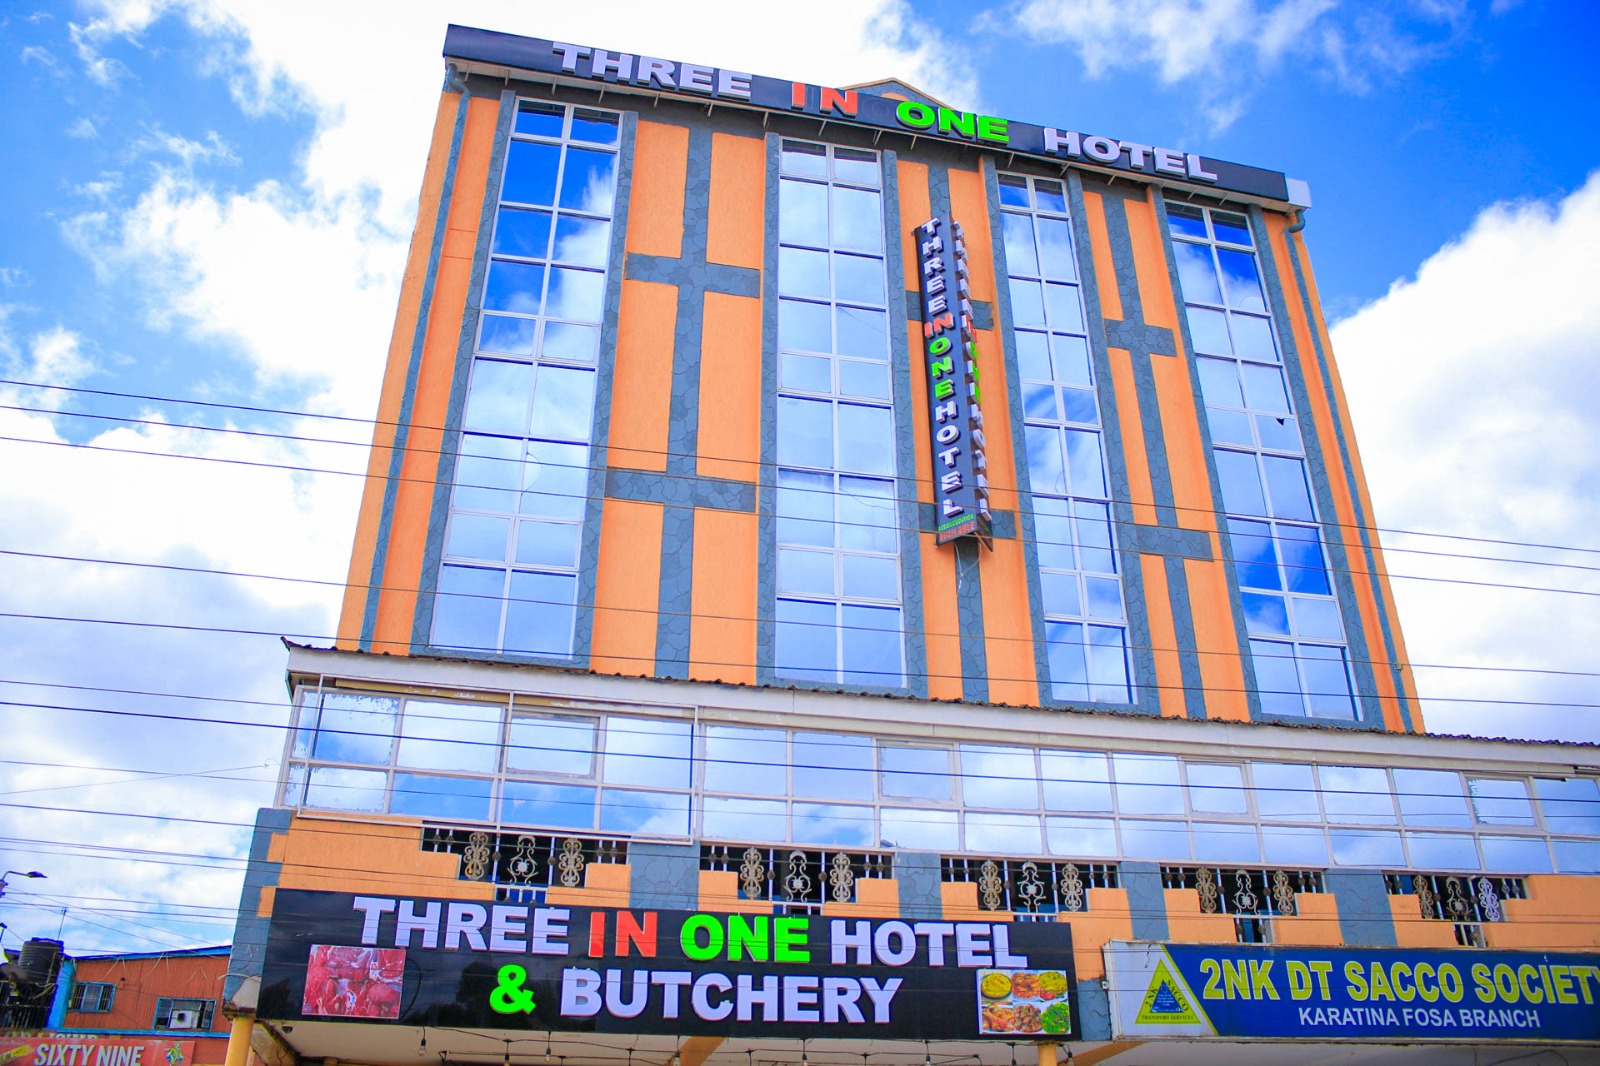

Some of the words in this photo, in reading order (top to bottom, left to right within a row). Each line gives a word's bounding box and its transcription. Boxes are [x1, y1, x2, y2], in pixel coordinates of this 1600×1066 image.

[552, 41, 752, 99] THREE
[791, 81, 858, 118] IN
[895, 101, 1010, 145] ONE
[1043, 127, 1218, 182] HOTEL
[921, 218, 947, 315] THREE
[924, 312, 954, 338] IN
[929, 337, 955, 400] ONE
[935, 400, 963, 518] HOTEL
[352, 896, 570, 955] THREE
[588, 911, 658, 958] IN
[680, 914, 810, 963] ONE
[830, 919, 1028, 969] HOTEL
[489, 964, 536, 1015] &
[560, 967, 903, 1024] BUTCHERY
[1200, 958, 1280, 1000] 2NK
[1286, 960, 1333, 1001] DT
[1344, 961, 1464, 1002] SACCO
[1298, 1007, 1400, 1026] KARATINA
[1402, 1008, 1457, 1027] FOSA
[1459, 1009, 1541, 1028] BRANCH
[33, 1043, 95, 1066] SIXTY
[95, 1045, 145, 1066] NINE
